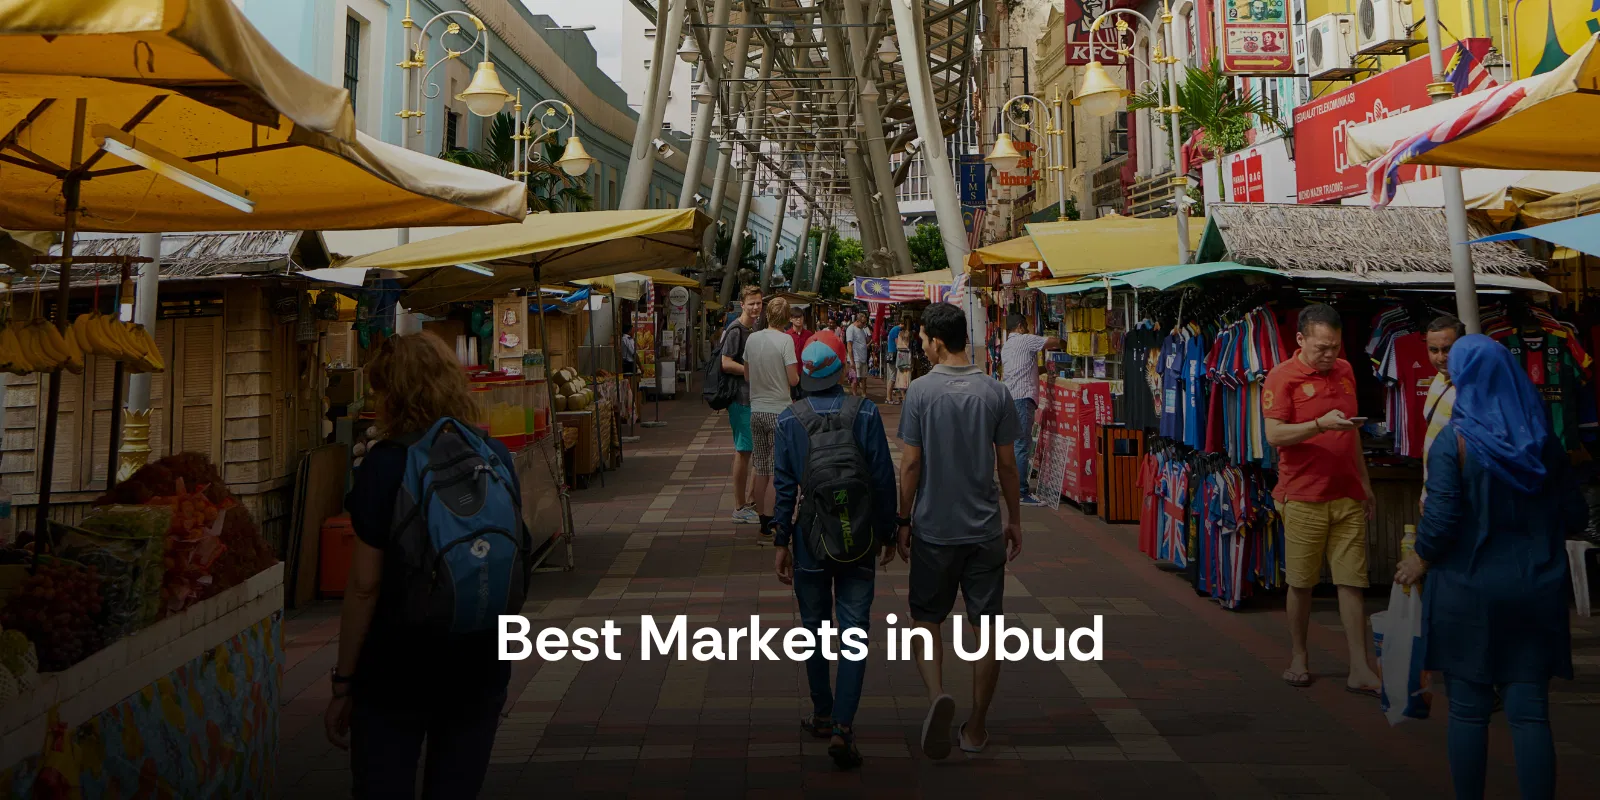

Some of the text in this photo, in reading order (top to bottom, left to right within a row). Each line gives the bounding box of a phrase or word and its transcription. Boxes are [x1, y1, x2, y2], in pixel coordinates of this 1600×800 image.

[1071, 46, 1115, 60] KFC
[968, 165, 978, 200] FTMS
[1249, 171, 1261, 183] BAG
